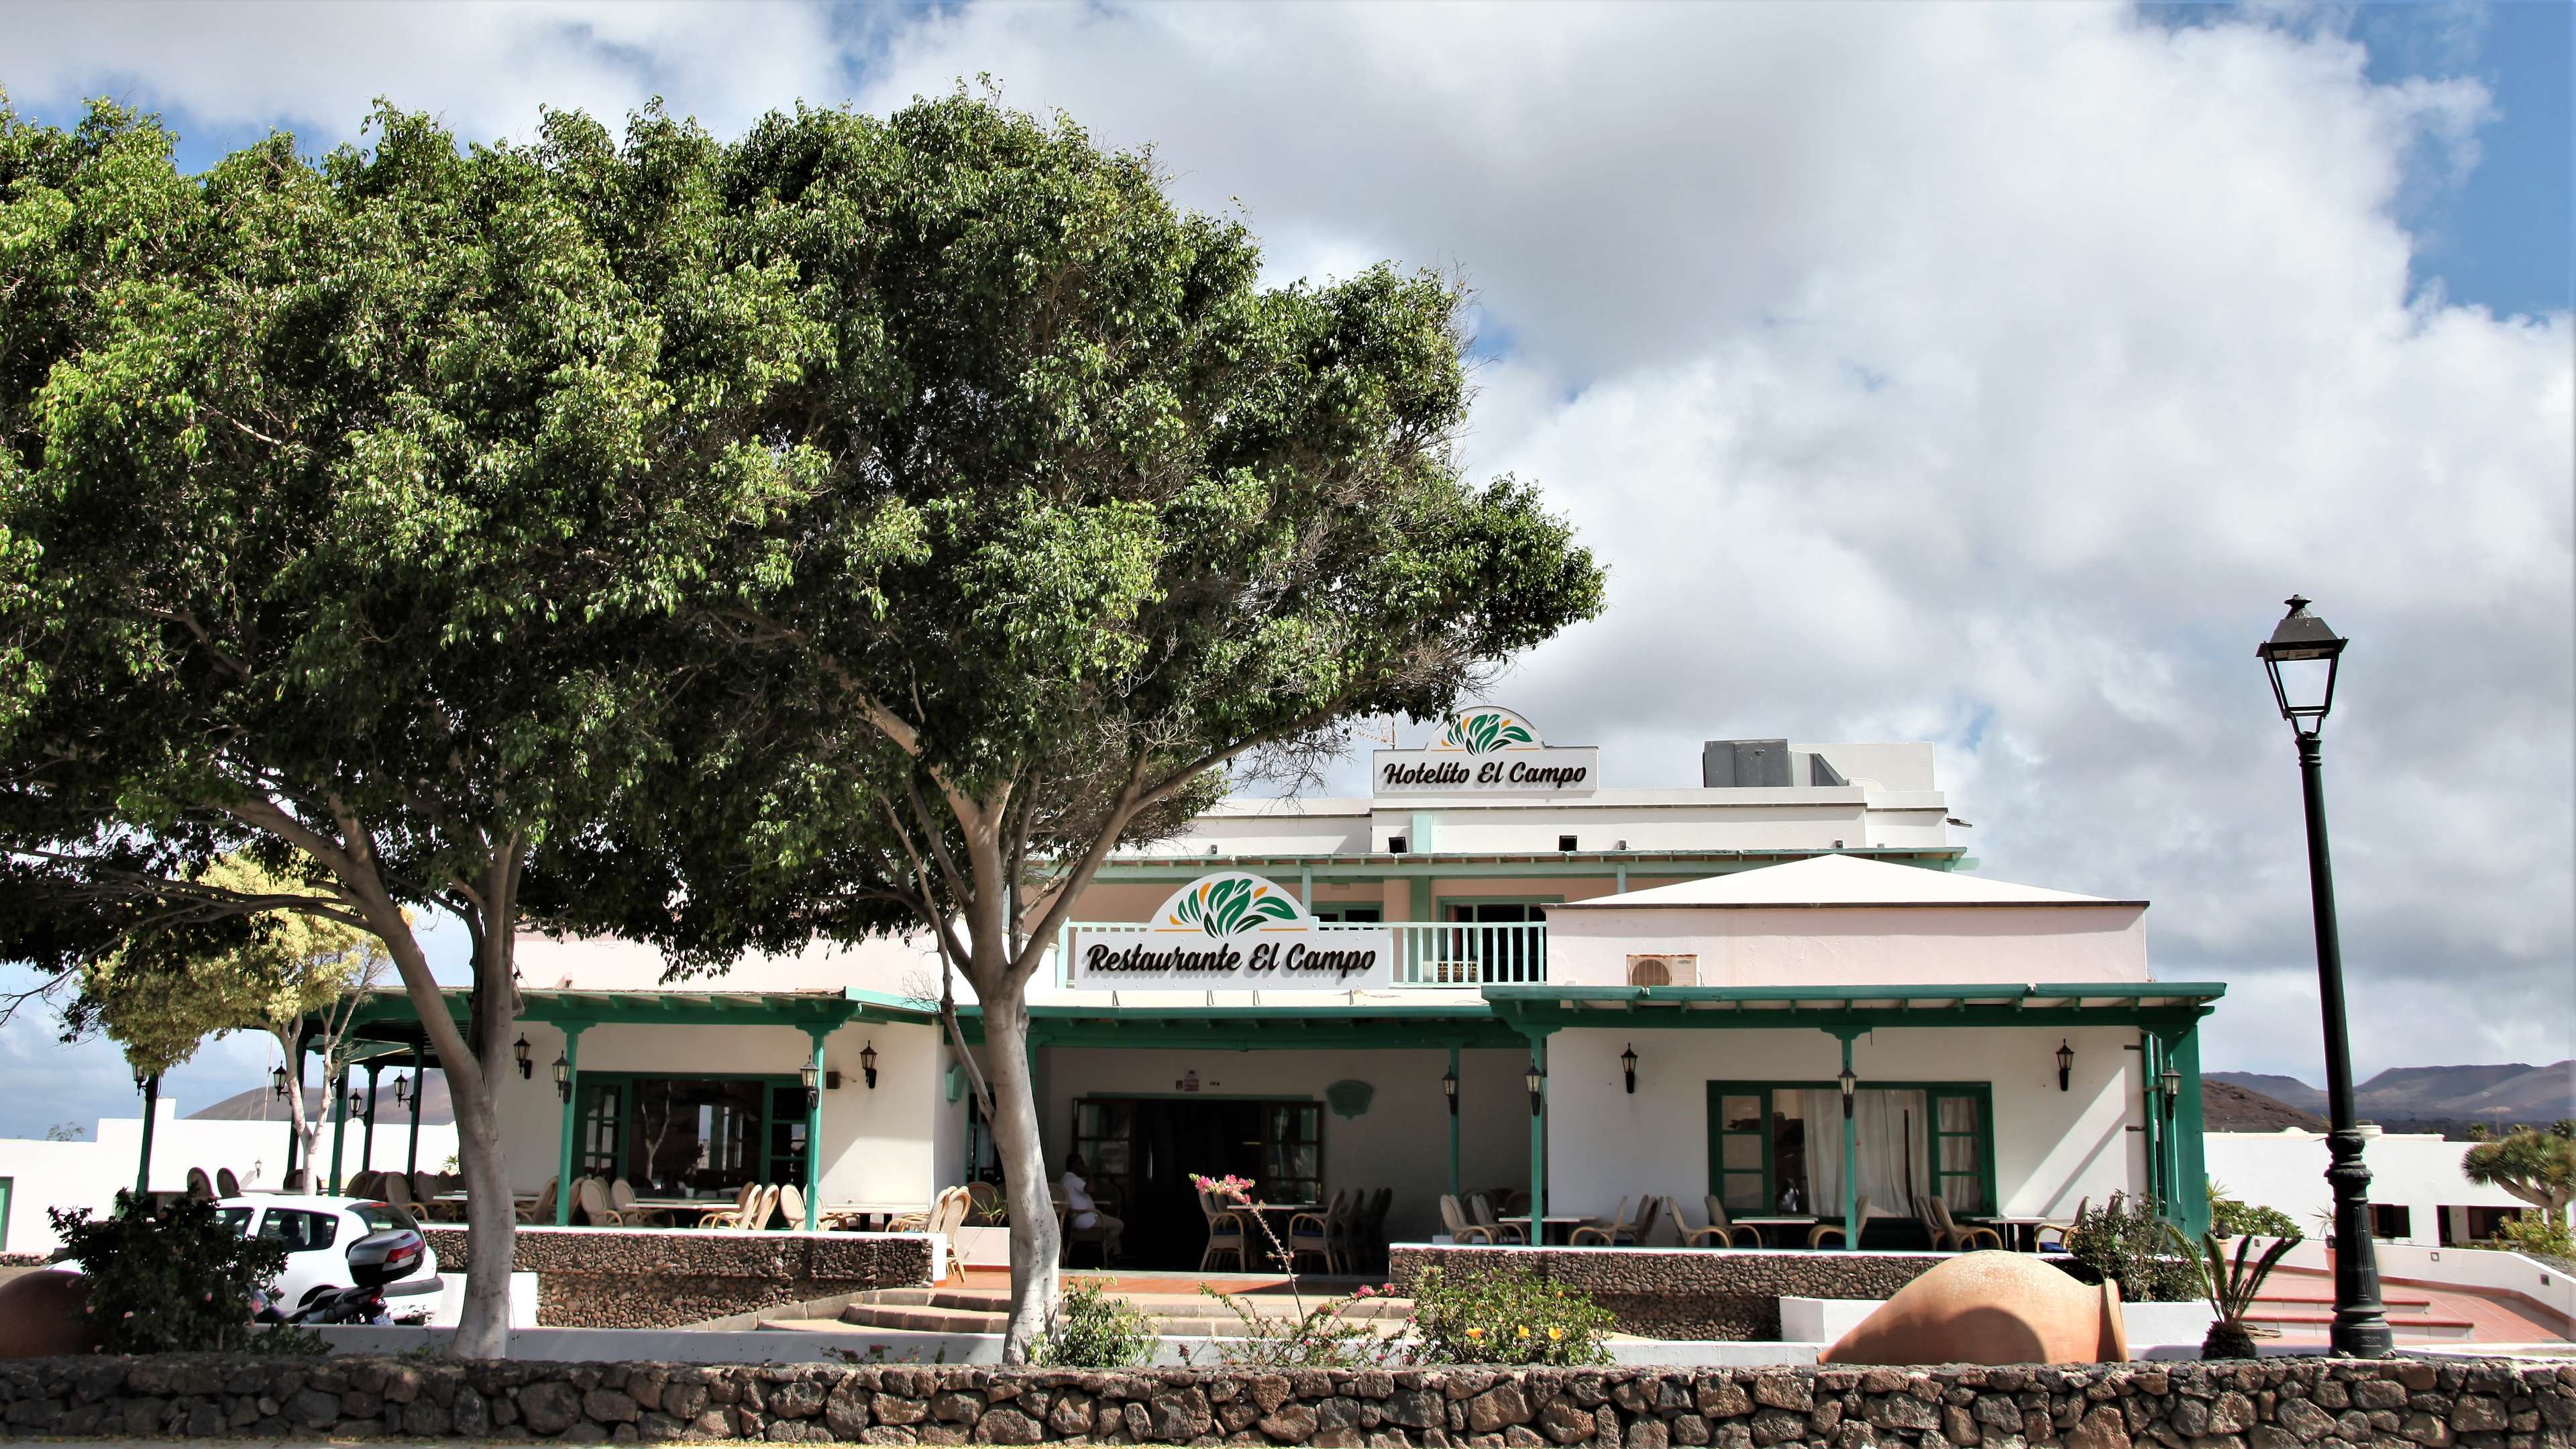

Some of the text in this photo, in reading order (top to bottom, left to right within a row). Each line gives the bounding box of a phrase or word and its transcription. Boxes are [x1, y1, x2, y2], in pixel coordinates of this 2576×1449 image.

[1383, 761, 1587, 789] Hotelito El Campo
[1087, 942, 1376, 979] Restaurante El Campo
